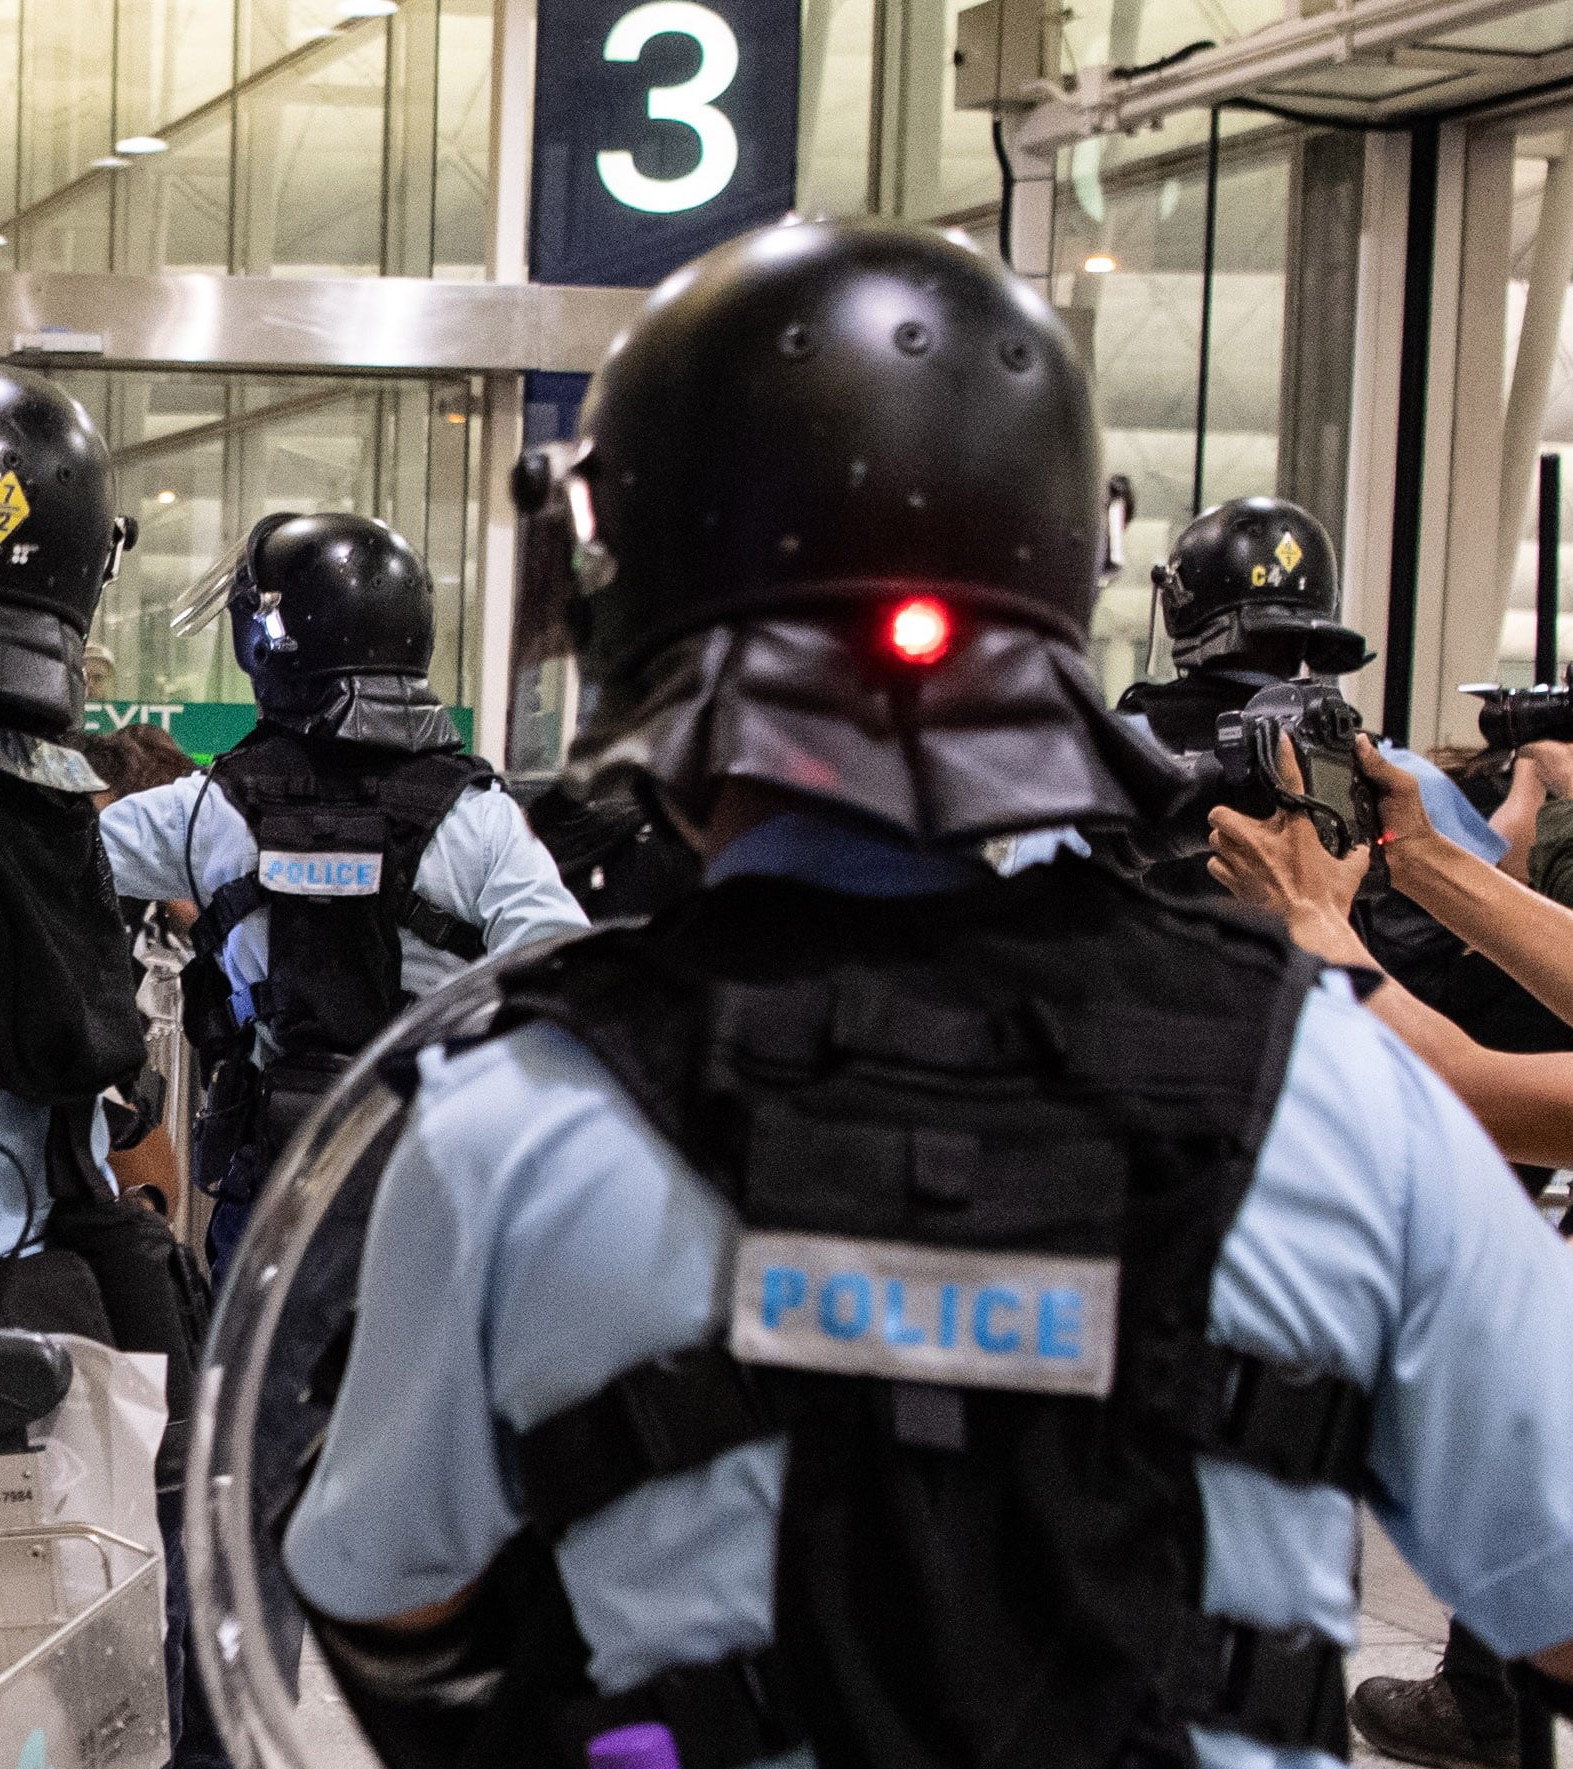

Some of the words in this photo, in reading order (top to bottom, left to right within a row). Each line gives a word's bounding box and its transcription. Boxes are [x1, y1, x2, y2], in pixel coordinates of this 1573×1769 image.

[595, 0, 740, 214] 3
[4, 484, 15, 504] 7
[1251, 564, 1283, 588] C4
[267, 860, 373, 885] POLICE
[761, 1263, 1084, 1360] POLICE
